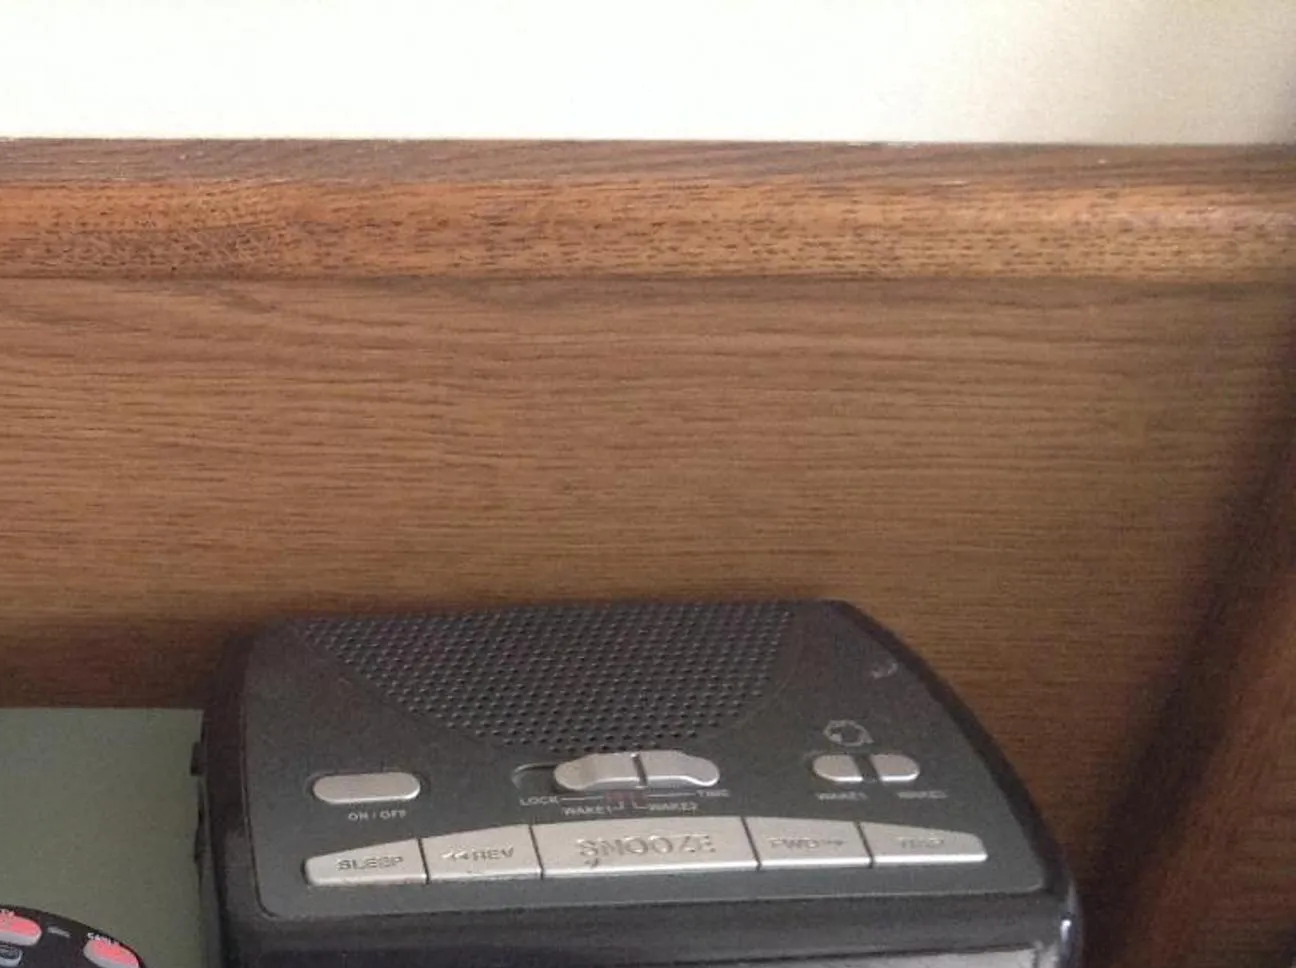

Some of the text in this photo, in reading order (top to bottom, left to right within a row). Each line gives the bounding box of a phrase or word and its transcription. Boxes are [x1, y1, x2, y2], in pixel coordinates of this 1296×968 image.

[519, 796, 560, 806] LOCK
[577, 834, 717, 858] SNOOZE
[471, 847, 515, 861] REV
[337, 856, 405, 871] SLEEP
